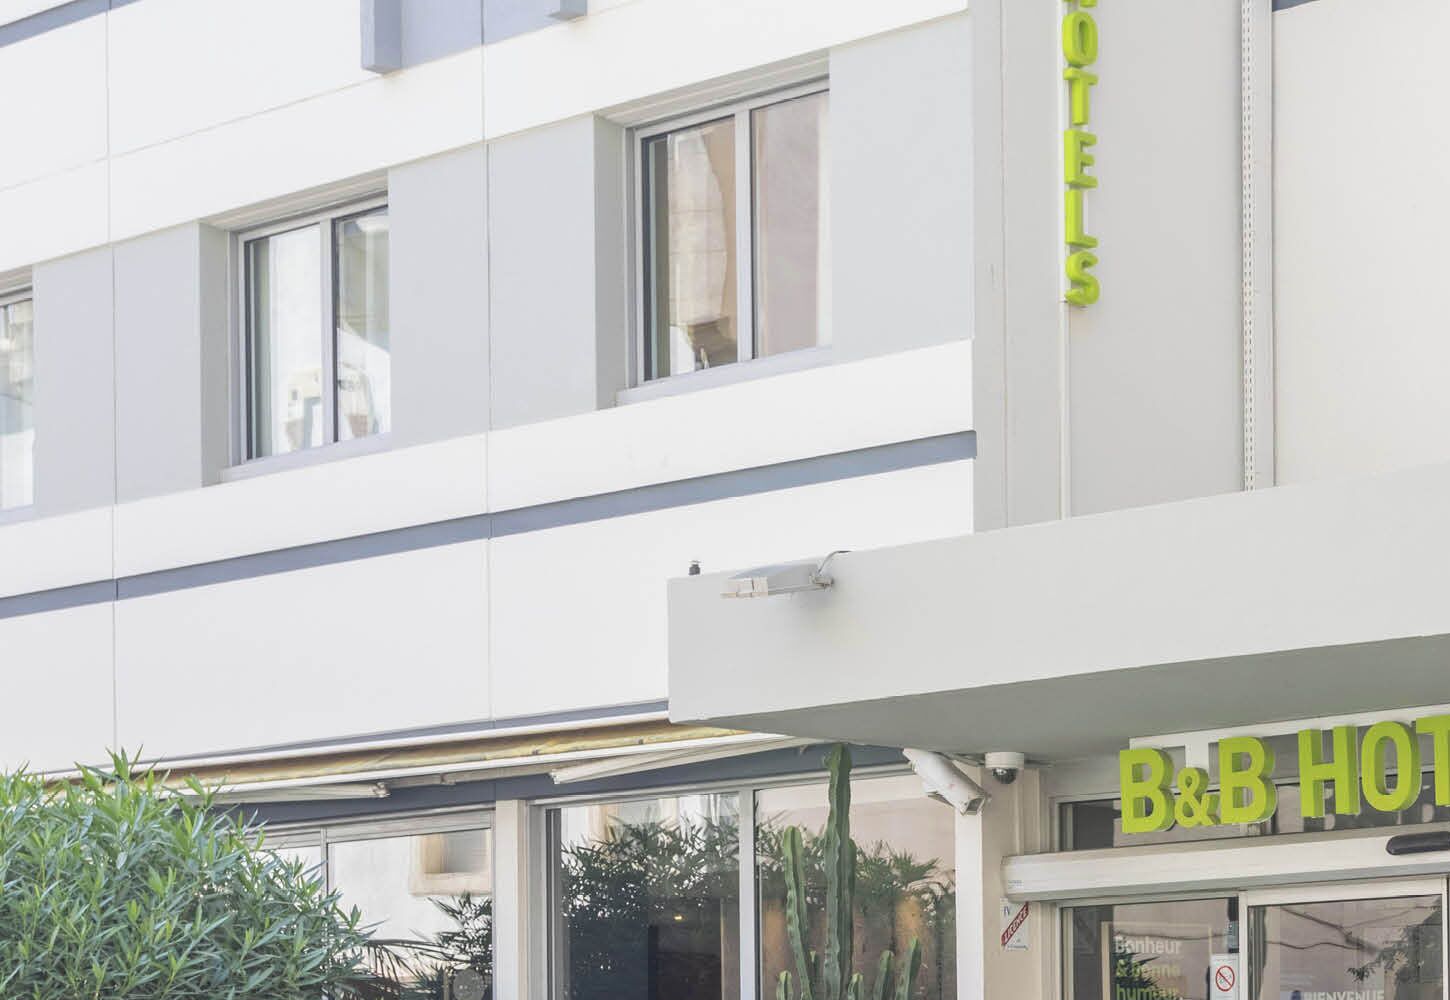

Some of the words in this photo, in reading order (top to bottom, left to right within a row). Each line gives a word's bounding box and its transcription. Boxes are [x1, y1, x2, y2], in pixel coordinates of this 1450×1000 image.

[1062, 0, 1099, 305] OTELS
[1119, 735, 1277, 834] B&B
[1114, 935, 1183, 954] Bonheur
